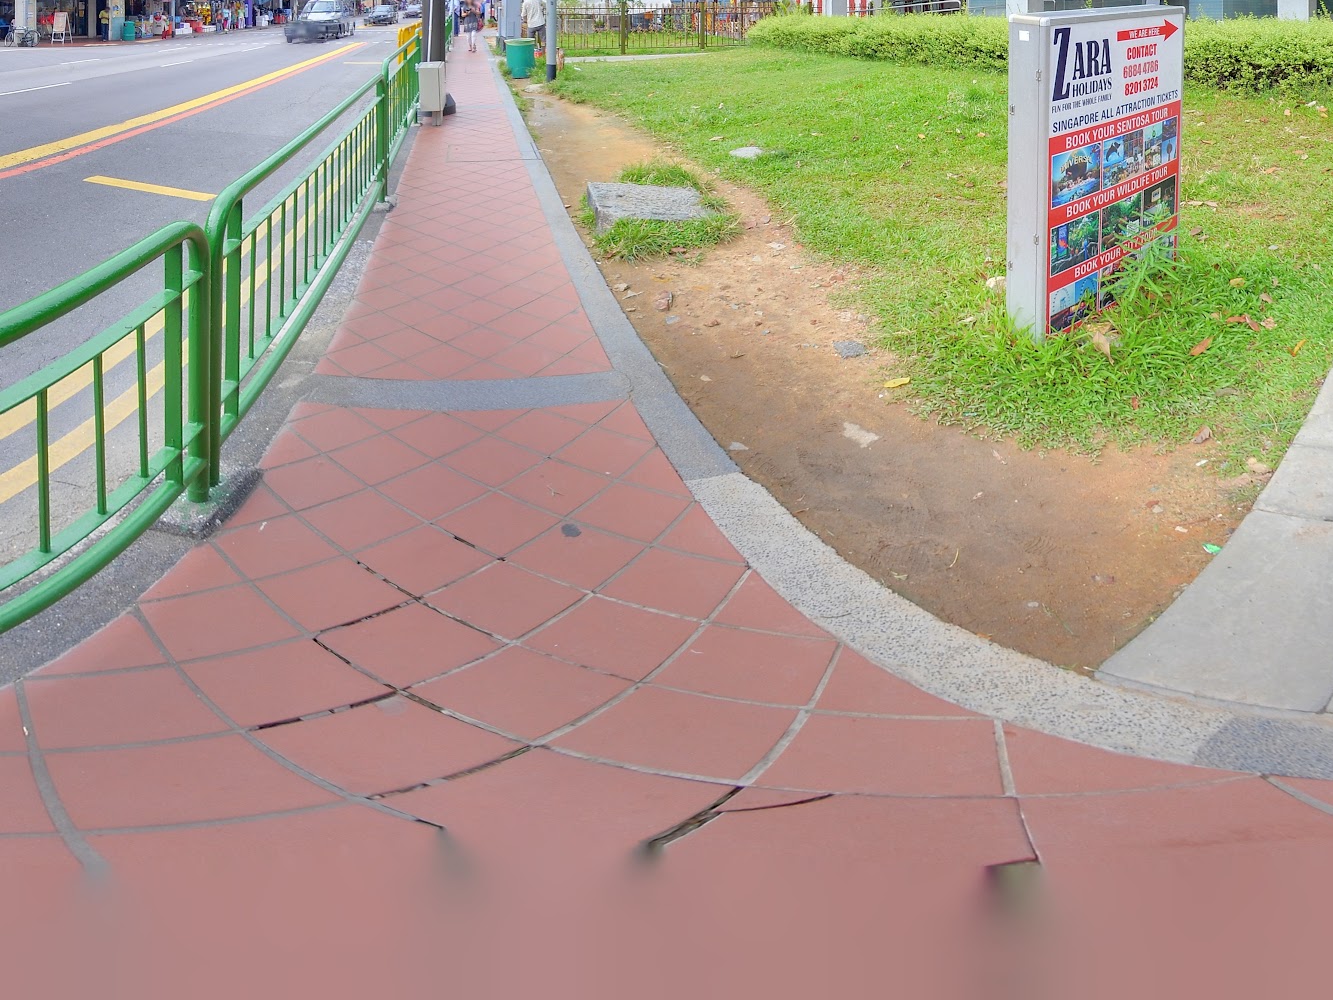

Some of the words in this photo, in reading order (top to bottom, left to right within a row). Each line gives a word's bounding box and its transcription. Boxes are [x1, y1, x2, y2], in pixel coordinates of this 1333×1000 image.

[1129, 31, 1137, 39] WE
[1138, 29, 1148, 37] ARE
[1149, 28, 1160, 36] HERE
[1127, 43, 1157, 60] CONTACT
[1052, 27, 1112, 102] ZARA
[1072, 77, 1112, 97] HOLIDAYS
[1124, 80, 1142, 96] 8201
[1142, 76, 1159, 92] 3724
[1052, 111, 1099, 133] SINGAPORE
[1101, 108, 1113, 120] ALL
[1115, 95, 1156, 117] ATTRACTION
[1157, 89, 1179, 103] TICKETS
[1062, 102, 1072, 111] FOR
[1072, 100, 1082, 109] THE
[1082, 96, 1097, 107] WHOLE
[1065, 133, 1091, 149] BOOK
[1092, 125, 1115, 141] YOUR
[1116, 114, 1150, 133] SENTOSA
[1151, 107, 1168, 121] TOUR
[1066, 201, 1091, 218] BOOK
[1092, 189, 1115, 207] YOUR
[1116, 174, 1150, 196] WILDLIFE
[1151, 166, 1168, 180] TOUR
[1074, 259, 1098, 278] BOOK
[1100, 248, 1121, 265] YOUR
